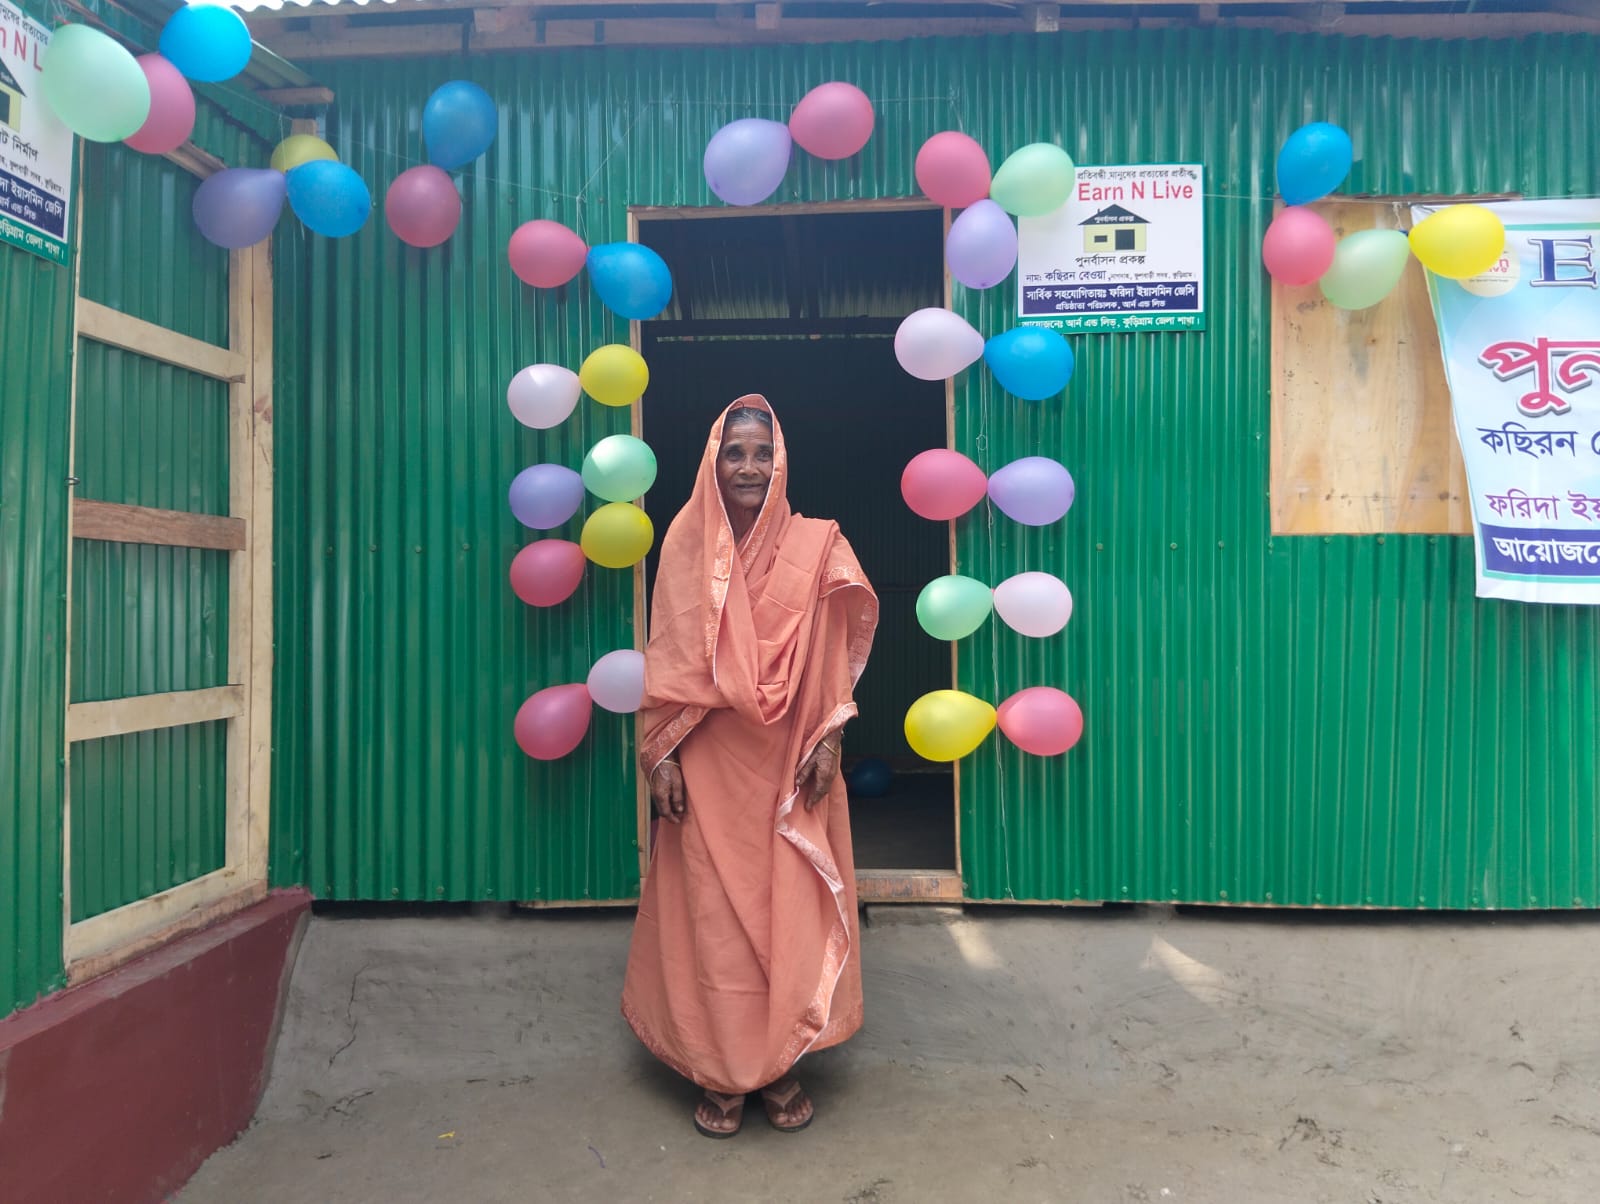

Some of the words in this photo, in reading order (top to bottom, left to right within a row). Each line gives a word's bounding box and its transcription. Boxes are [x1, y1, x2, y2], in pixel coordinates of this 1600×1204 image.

[14, 29, 26, 61] N
[1078, 183, 1124, 201] Earn
[1132, 181, 1145, 199] N
[1153, 181, 1193, 199] Live
[1075, 253, 1117, 268] পুনর্বাসন
[1119, 255, 1146, 265] প্রকল্প
[1043, 269, 1076, 281] কছিরন
[1026, 288, 1052, 301] সার্বিক
[1108, 285, 1134, 297] ফরিদা
[1136, 284, 1172, 297] ইয়াসমিন
[1155, 316, 1175, 325] জেলা
[1476, 421, 1579, 459] কছিরন
[1485, 488, 1561, 521] ফরিদা
